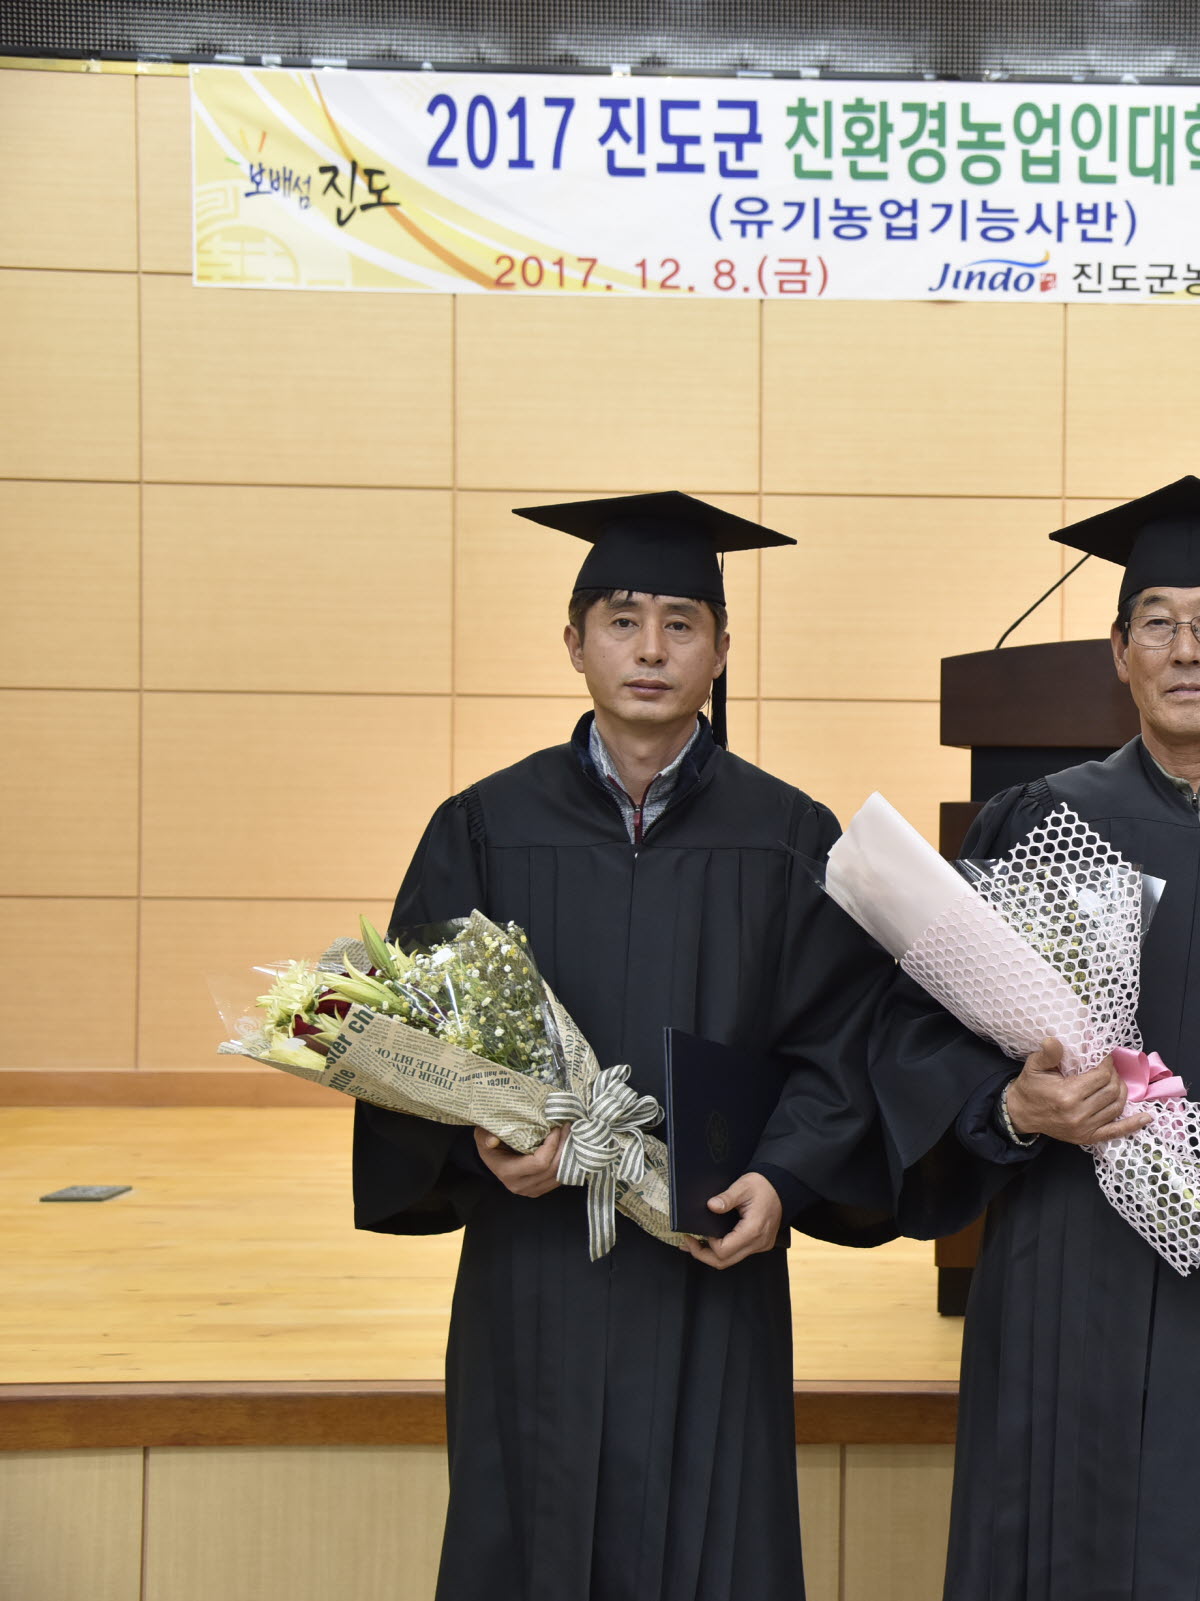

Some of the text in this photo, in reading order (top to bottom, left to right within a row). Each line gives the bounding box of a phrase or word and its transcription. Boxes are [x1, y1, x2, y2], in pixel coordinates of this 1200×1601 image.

[427, 93, 575, 170] 2017
[598, 97, 762, 179] 진도군
[244, 160, 401, 227] 보배섬 진도
[709, 193, 1137, 246] (유기농업기능사반)
[493, 255, 830, 294] 2017. 12. 8.(금)
[928, 262, 1036, 292] Jindo
[393, 1052, 414, 1067] BIT
[416, 1063, 459, 1083] LITTLE
[418, 1072, 454, 1092] THEIR
